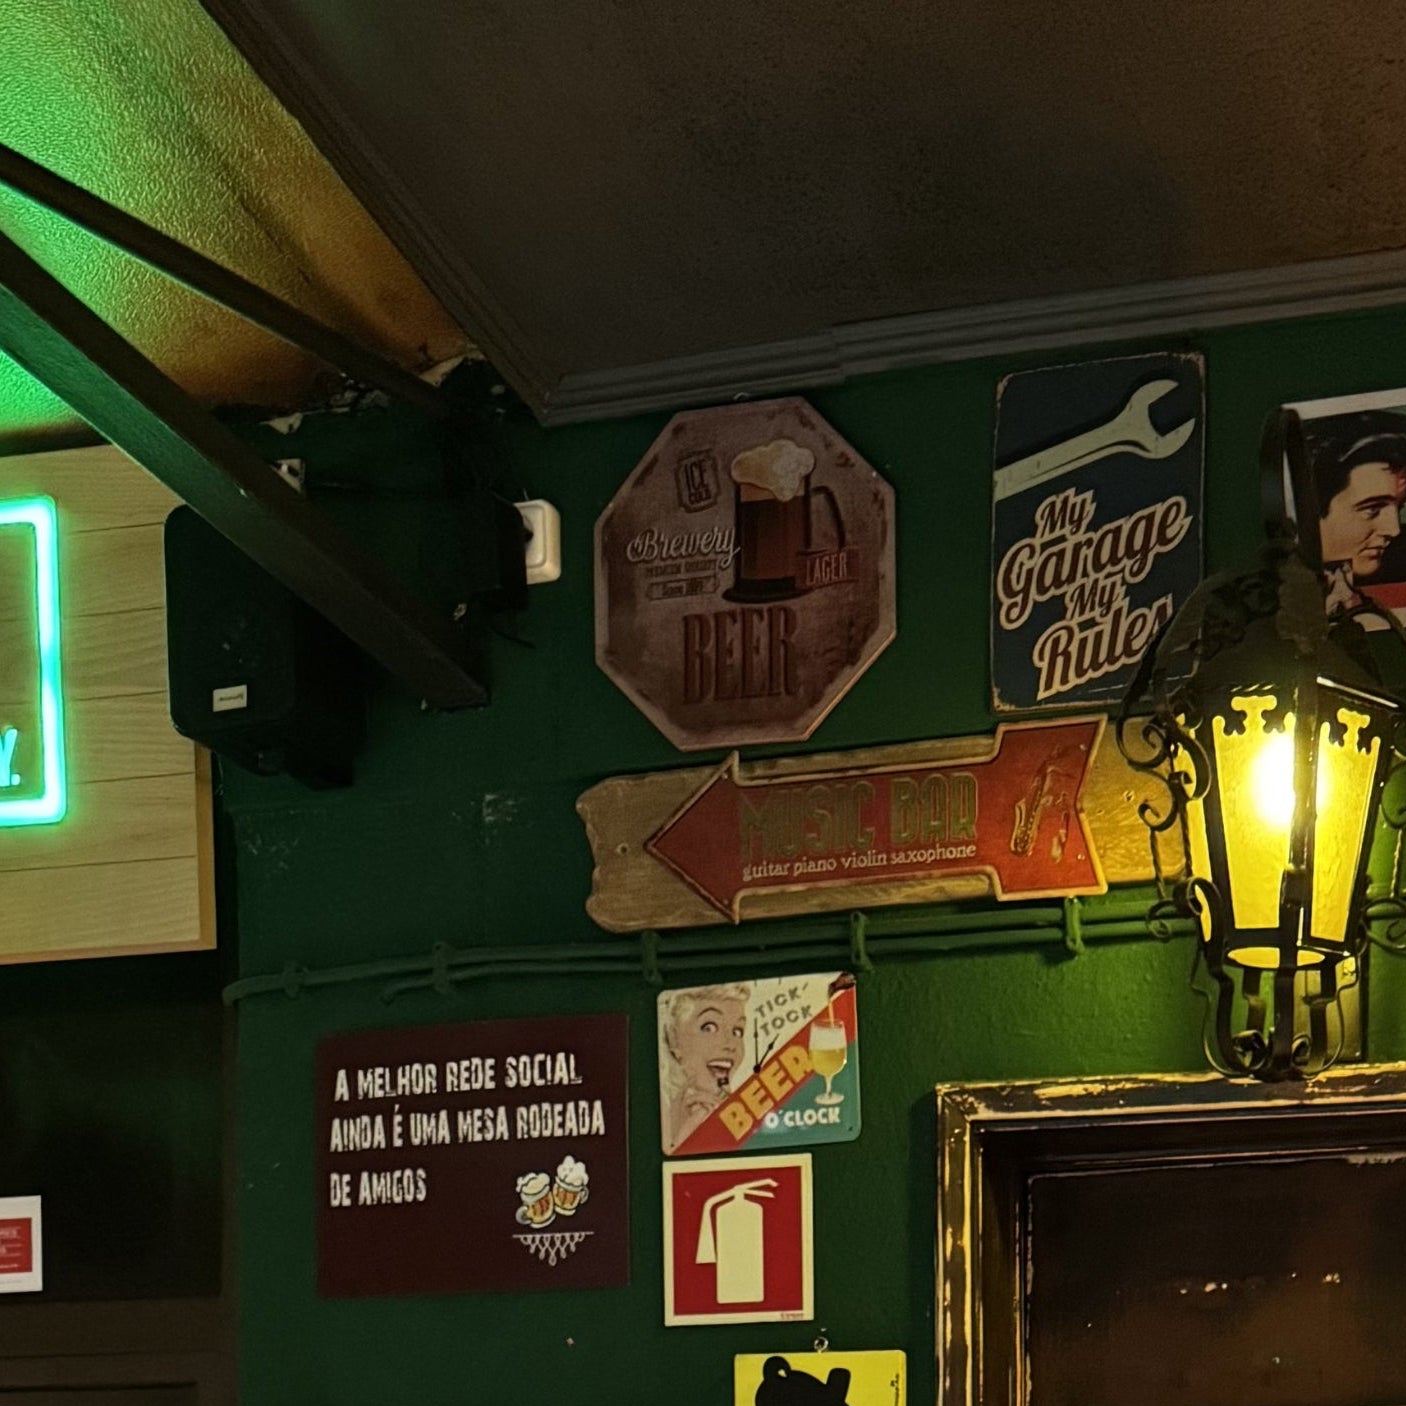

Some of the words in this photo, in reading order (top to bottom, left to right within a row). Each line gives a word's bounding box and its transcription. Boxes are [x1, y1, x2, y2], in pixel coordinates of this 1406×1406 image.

[685, 456, 708, 493] ICE
[1036, 488, 1094, 540] My
[626, 525, 741, 568] Brewery
[805, 551, 849, 586] LAGER
[997, 496, 1194, 629] Garage
[1065, 570, 1129, 621] My
[683, 607, 800, 704] BEER
[740, 780, 878, 861] MUSIC
[890, 772, 978, 845] BAR
[742, 861, 790, 882] guitar
[793, 855, 837, 876] piano
[842, 849, 887, 869] violin
[890, 842, 976, 864] saxophone
[760, 1004, 813, 1038] TOCK
[334, 1069, 349, 1101] A
[357, 1062, 438, 1100] MELHOR
[446, 1057, 496, 1092] REDE
[504, 1052, 583, 1089] SOCIAL
[719, 1045, 814, 1141] BEER
[330, 1114, 386, 1152] AINDA
[393, 1104, 403, 1148] É
[410, 1109, 450, 1146] UMA
[457, 1105, 509, 1144] MESA
[516, 1100, 605, 1140] RODEADA
[330, 1172, 351, 1207] DE
[358, 1168, 426, 1206] AMIGOS
